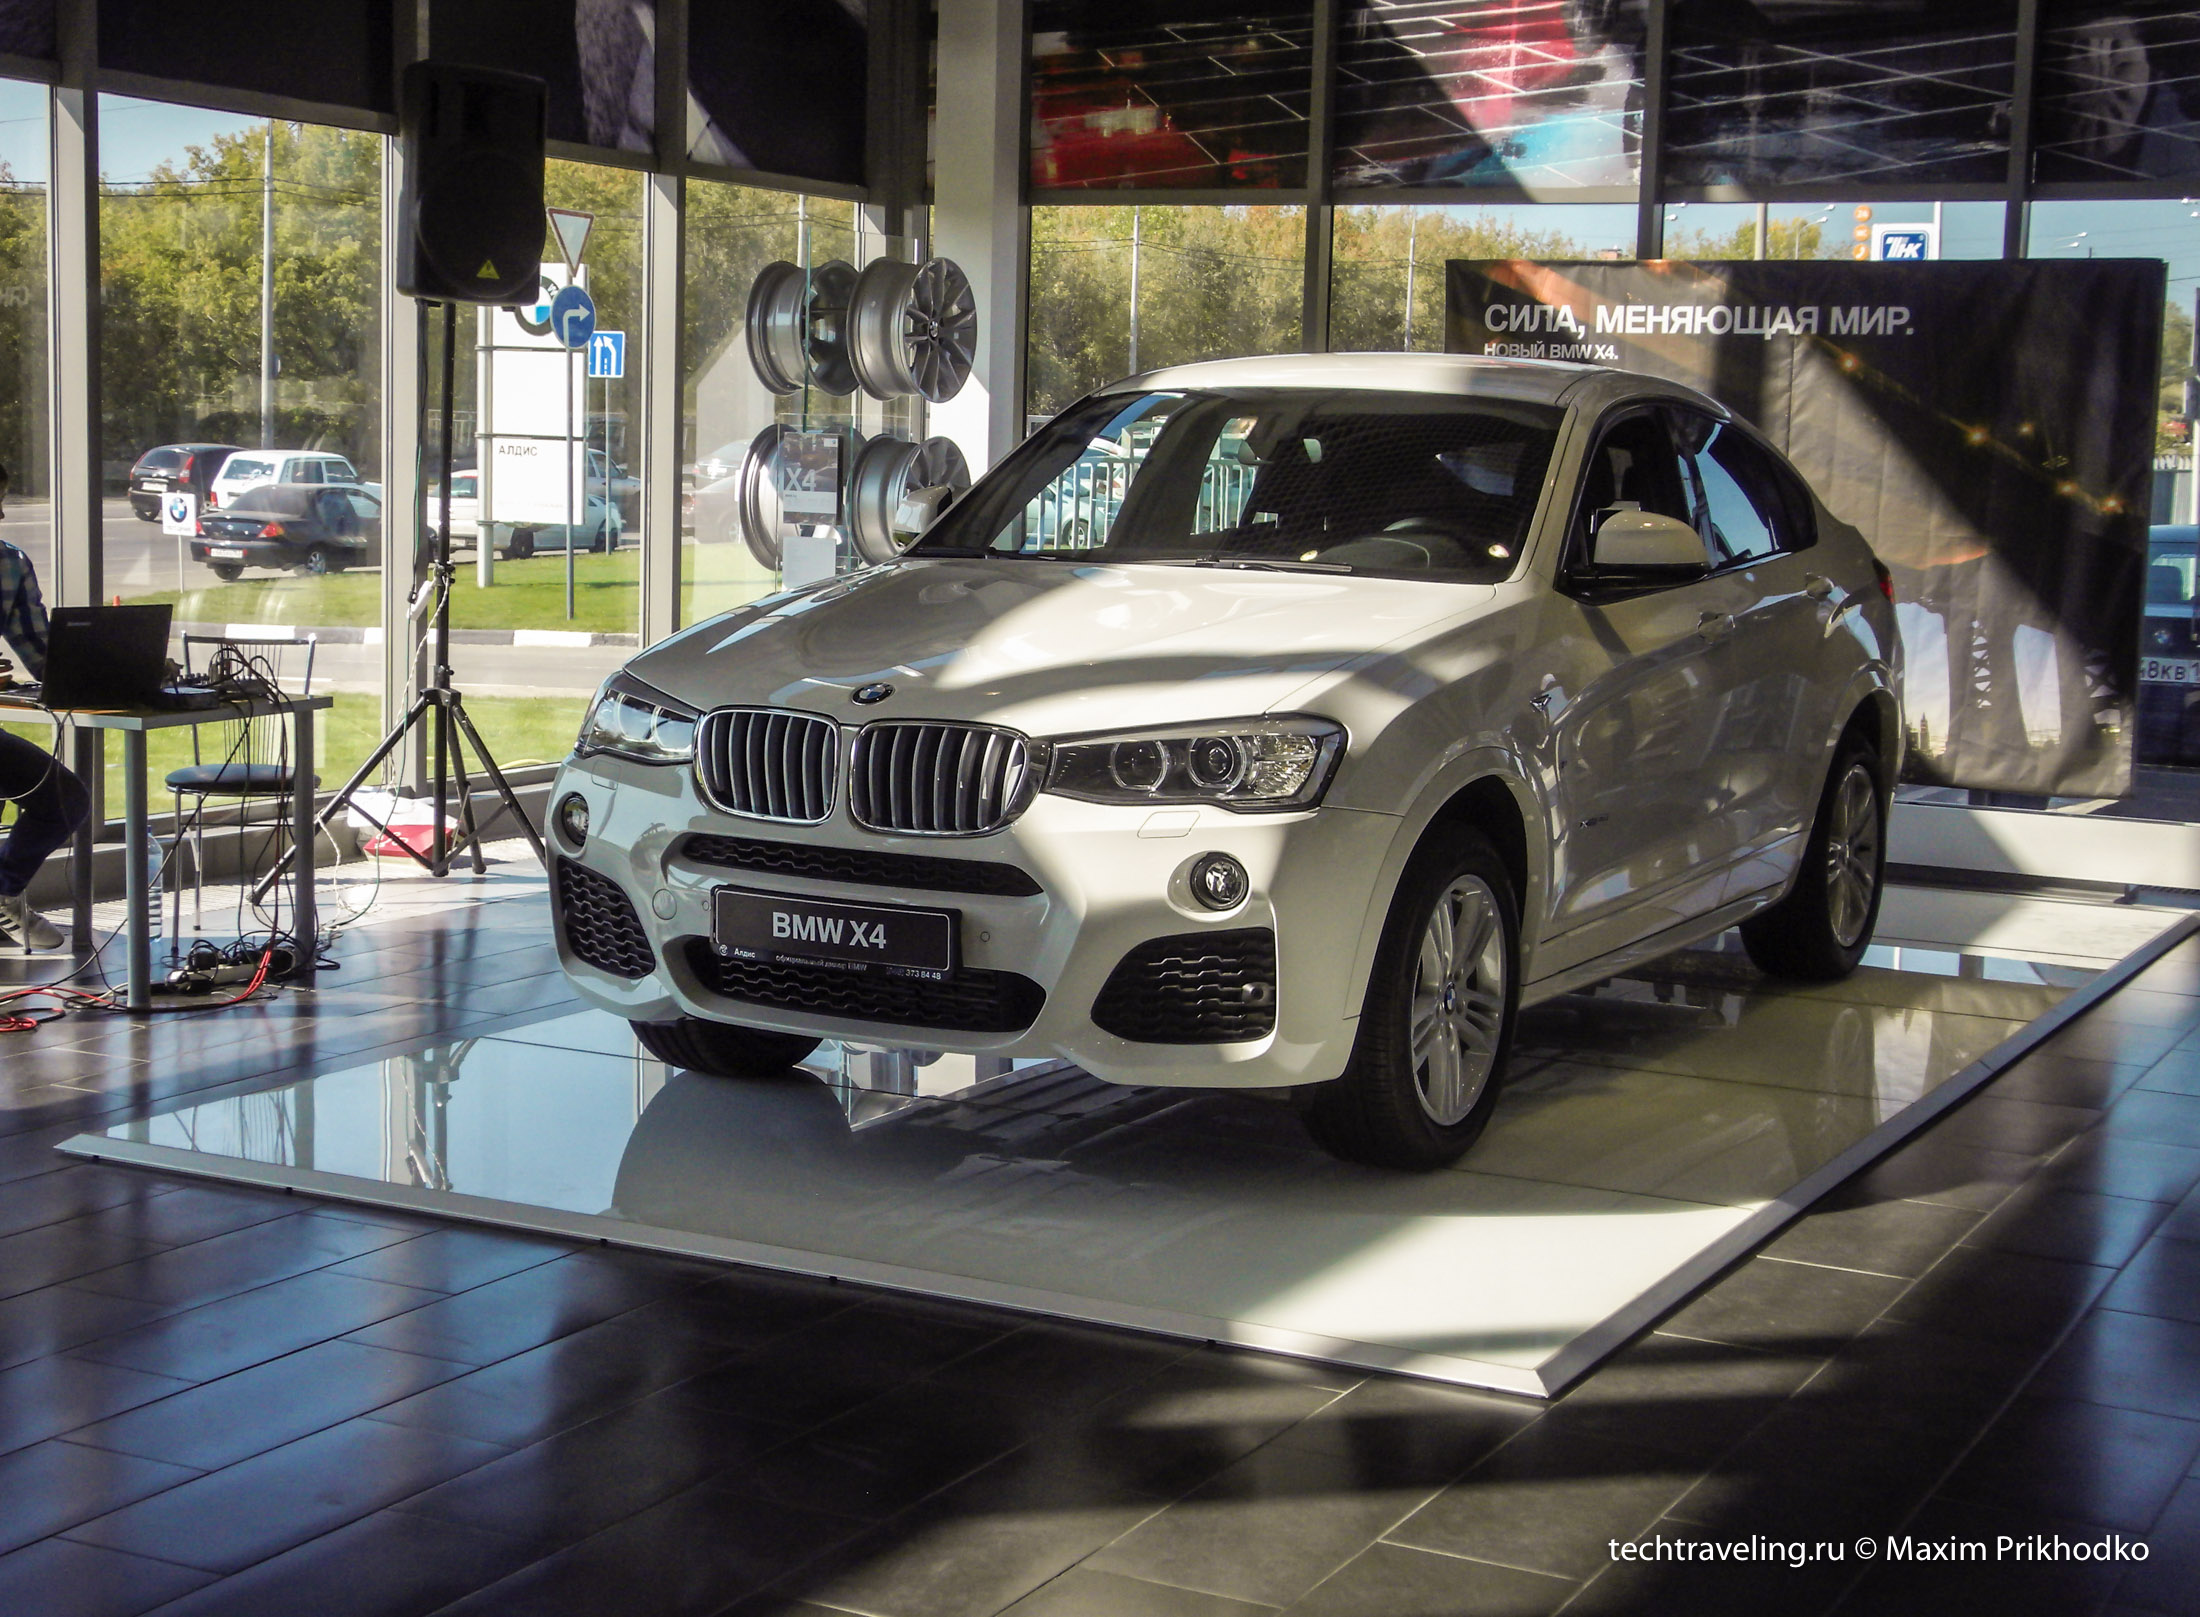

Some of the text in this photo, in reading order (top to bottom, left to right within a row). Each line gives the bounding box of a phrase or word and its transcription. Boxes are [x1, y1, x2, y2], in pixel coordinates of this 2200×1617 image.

[1484, 303, 1915, 340] СИЛА, МЕНЯЮЩАЯ МИР.
[1484, 340, 1618, 359] НОВЫЙ BMW X4.
[498, 445, 538, 457] АЛДИС
[785, 467, 817, 492] X4
[772, 911, 887, 949] BMW X4
[734, 947, 756, 959] Алдис
[905, 969, 920, 978] 373
